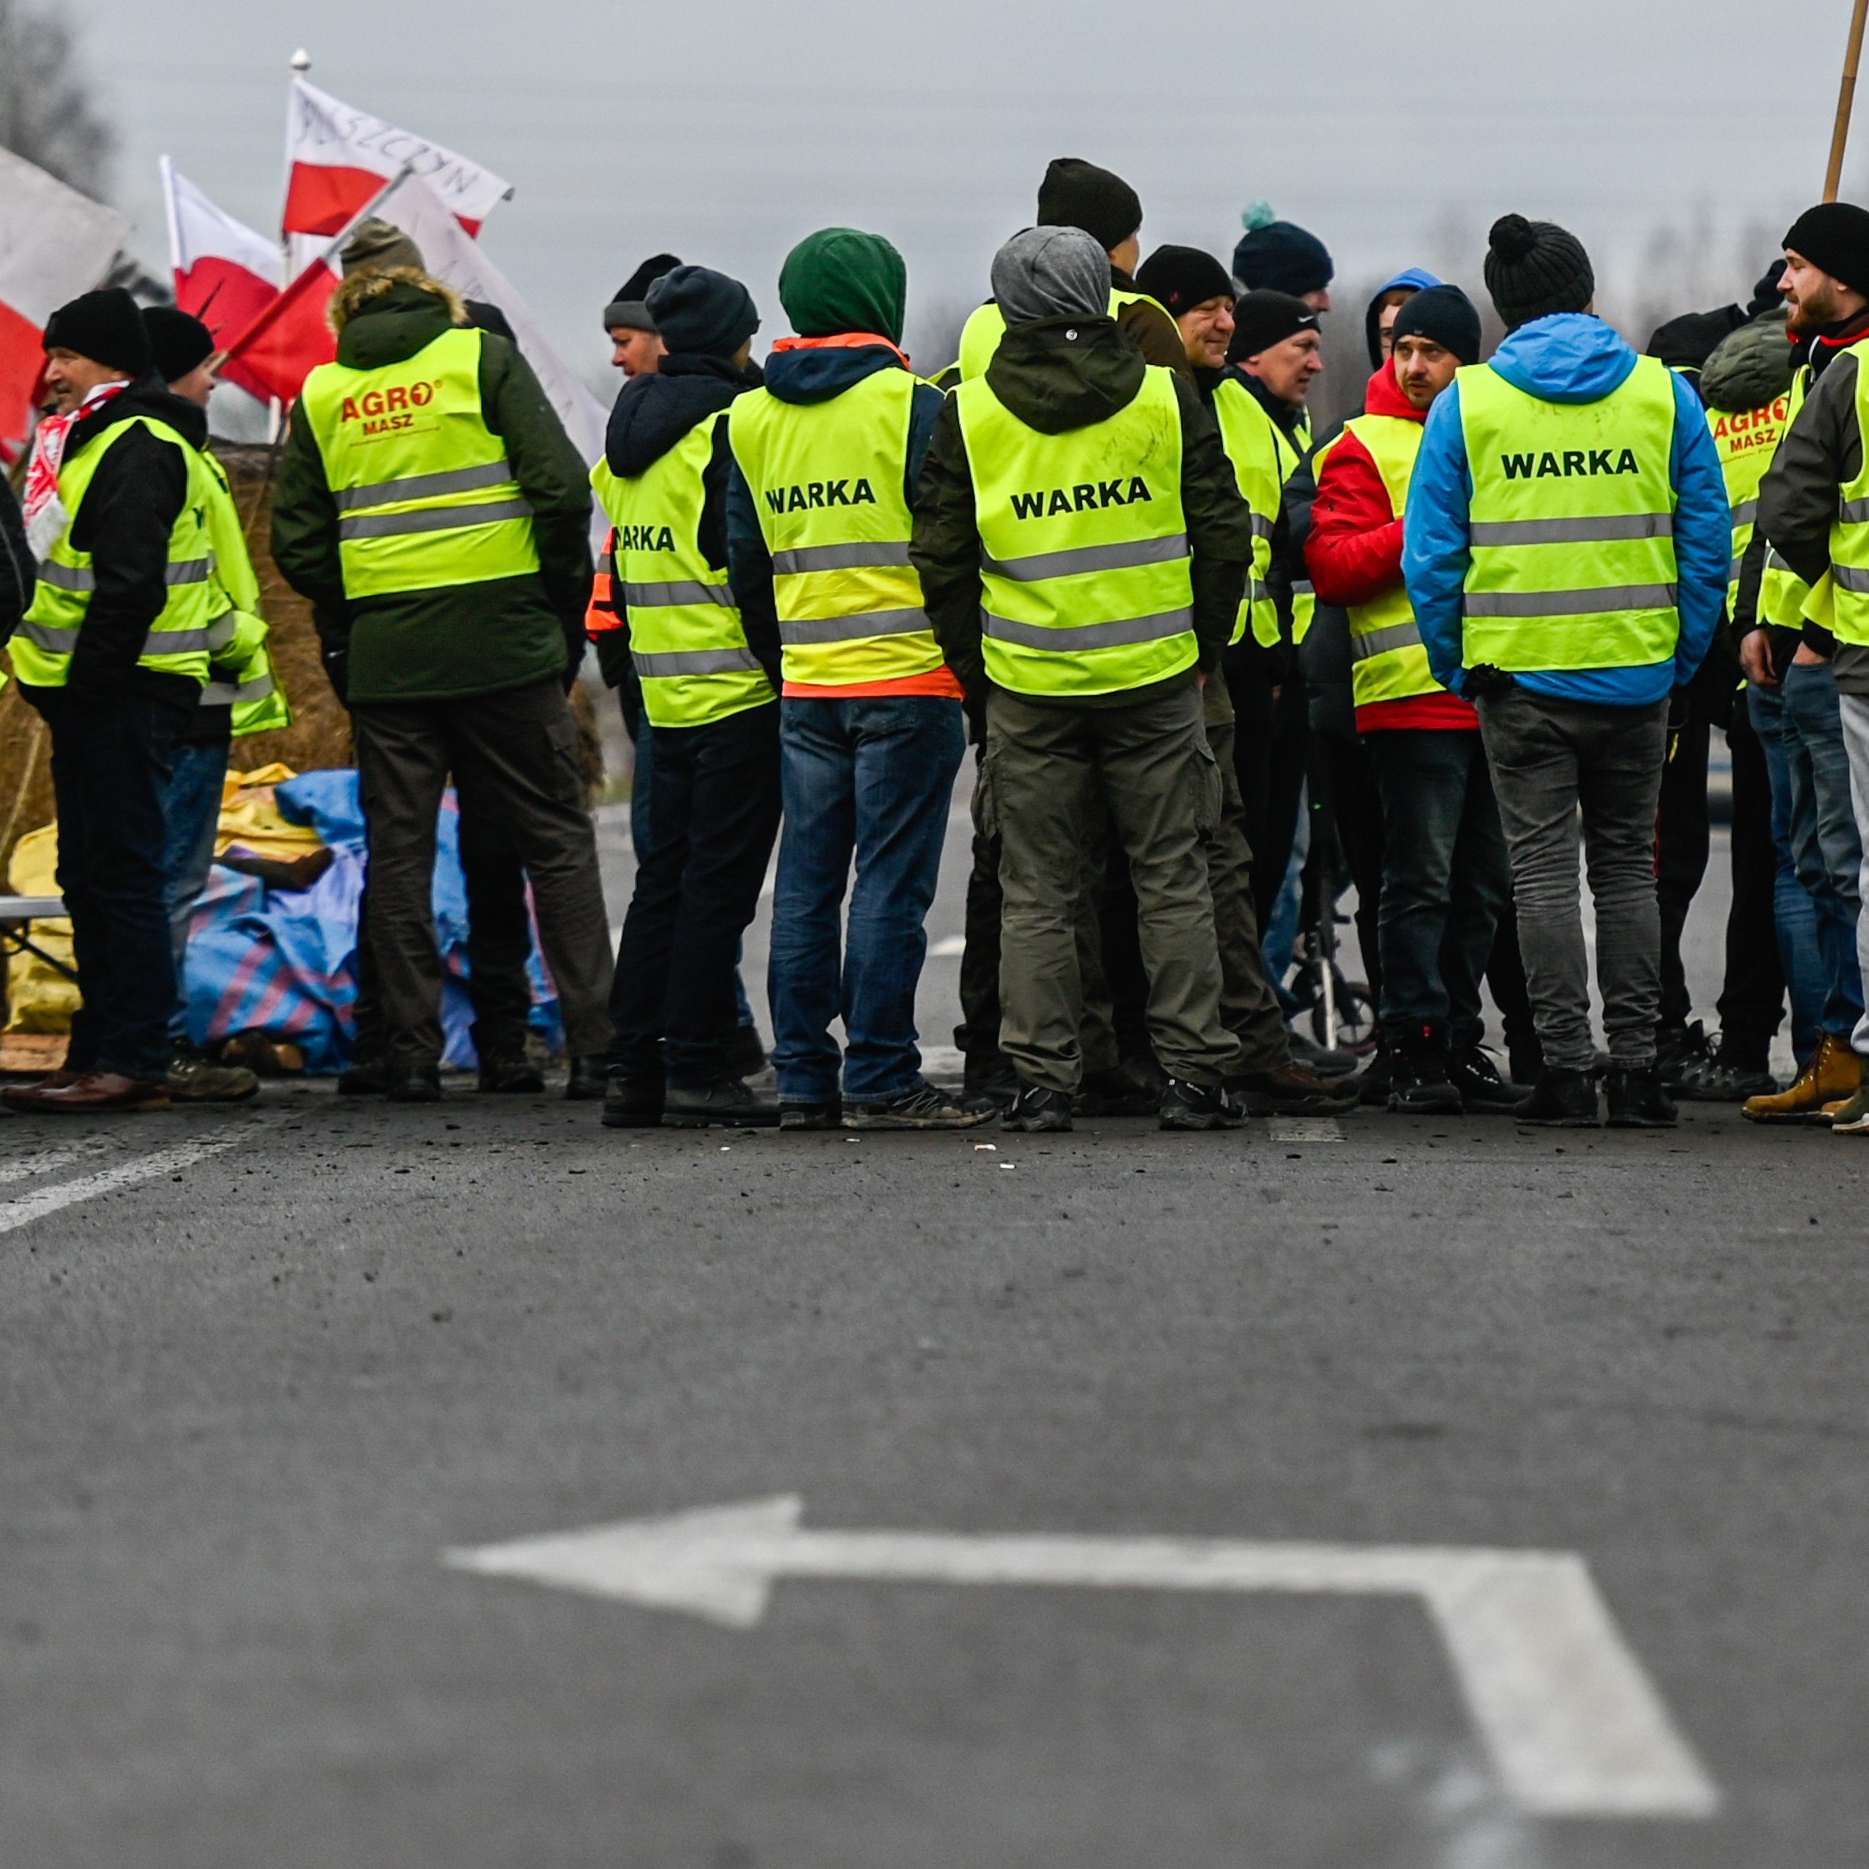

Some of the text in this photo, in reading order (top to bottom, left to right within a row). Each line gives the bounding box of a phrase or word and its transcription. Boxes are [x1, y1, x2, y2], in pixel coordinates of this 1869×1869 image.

[341, 381, 434, 423] AGRO
[1714, 396, 1791, 441] AGRO
[363, 413, 414, 436] MASZ
[1730, 429, 1778, 453] MASZ
[1500, 448, 1639, 480] WARKA
[765, 478, 877, 515] WARKA
[1010, 476, 1153, 520] WARKA
